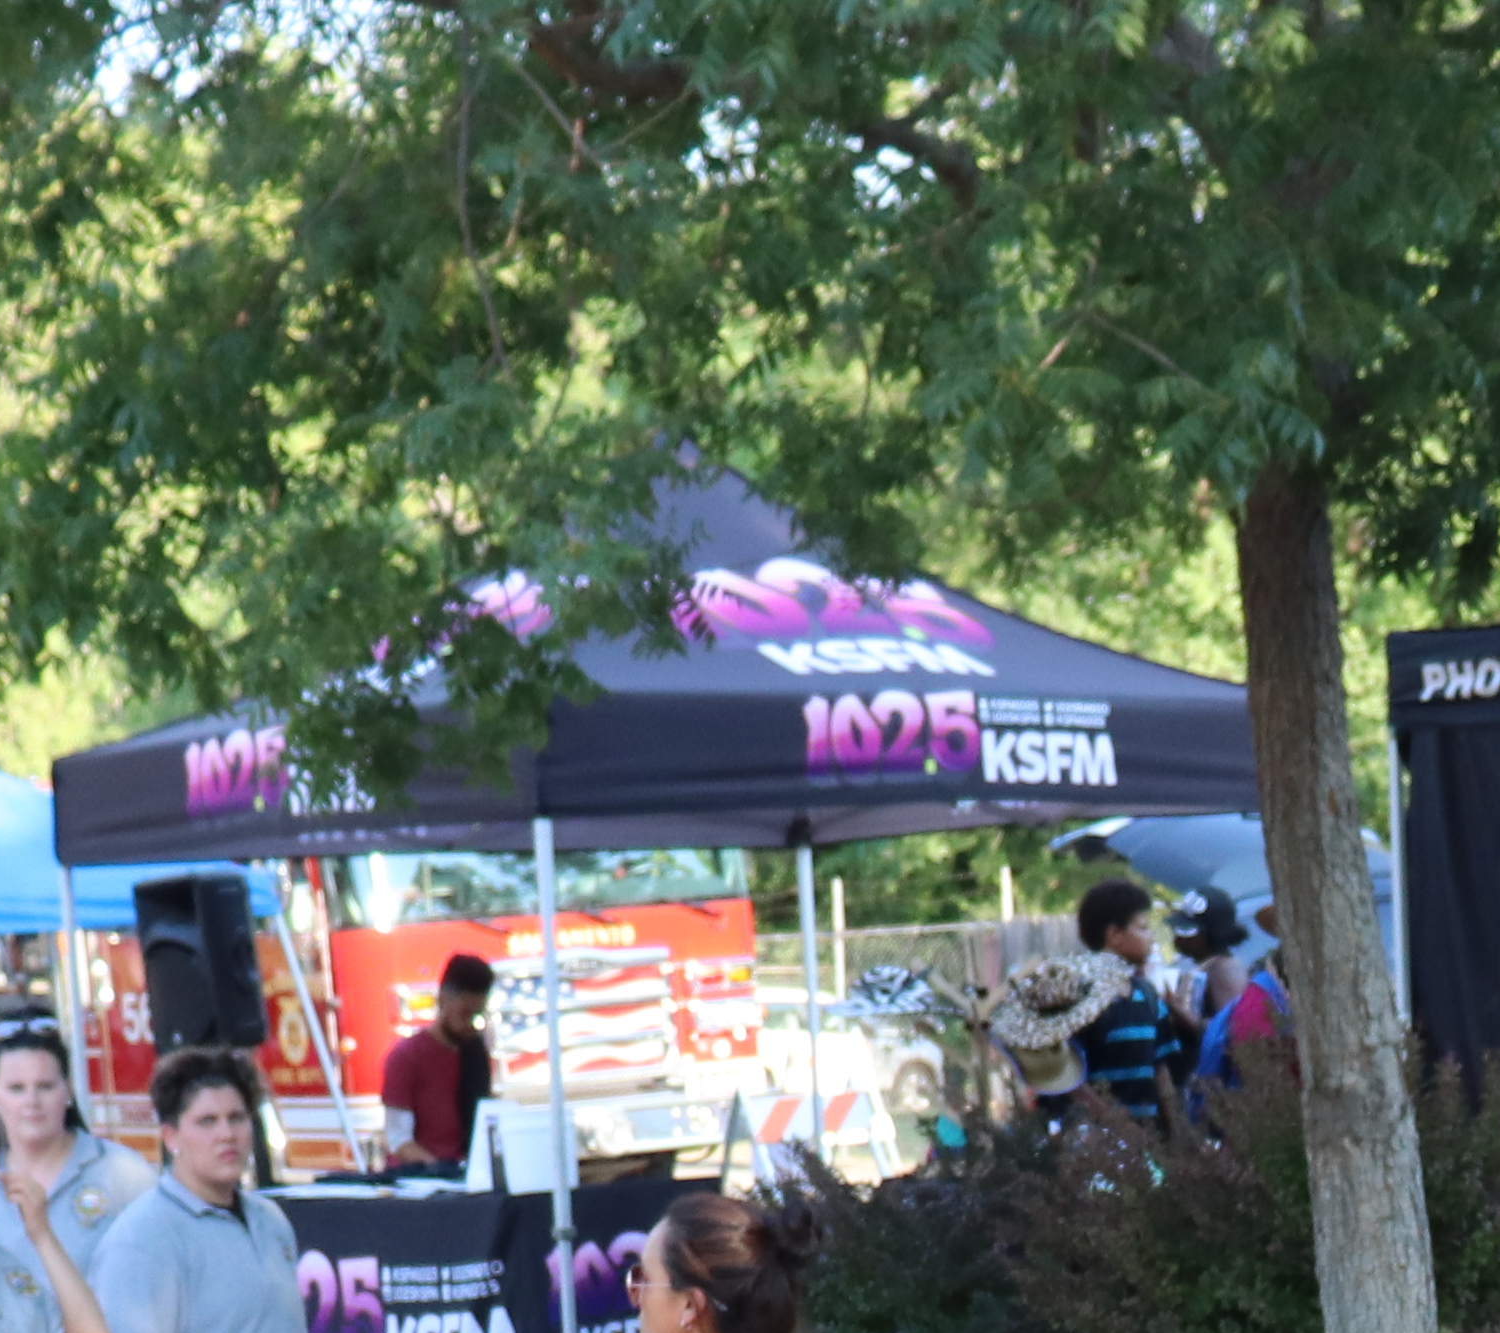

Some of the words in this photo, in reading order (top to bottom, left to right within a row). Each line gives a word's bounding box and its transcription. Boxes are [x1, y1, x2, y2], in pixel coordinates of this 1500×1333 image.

[757, 638, 996, 678] KSFM
[803, 689, 981, 778] 102.5
[980, 730, 1118, 787] KSFM
